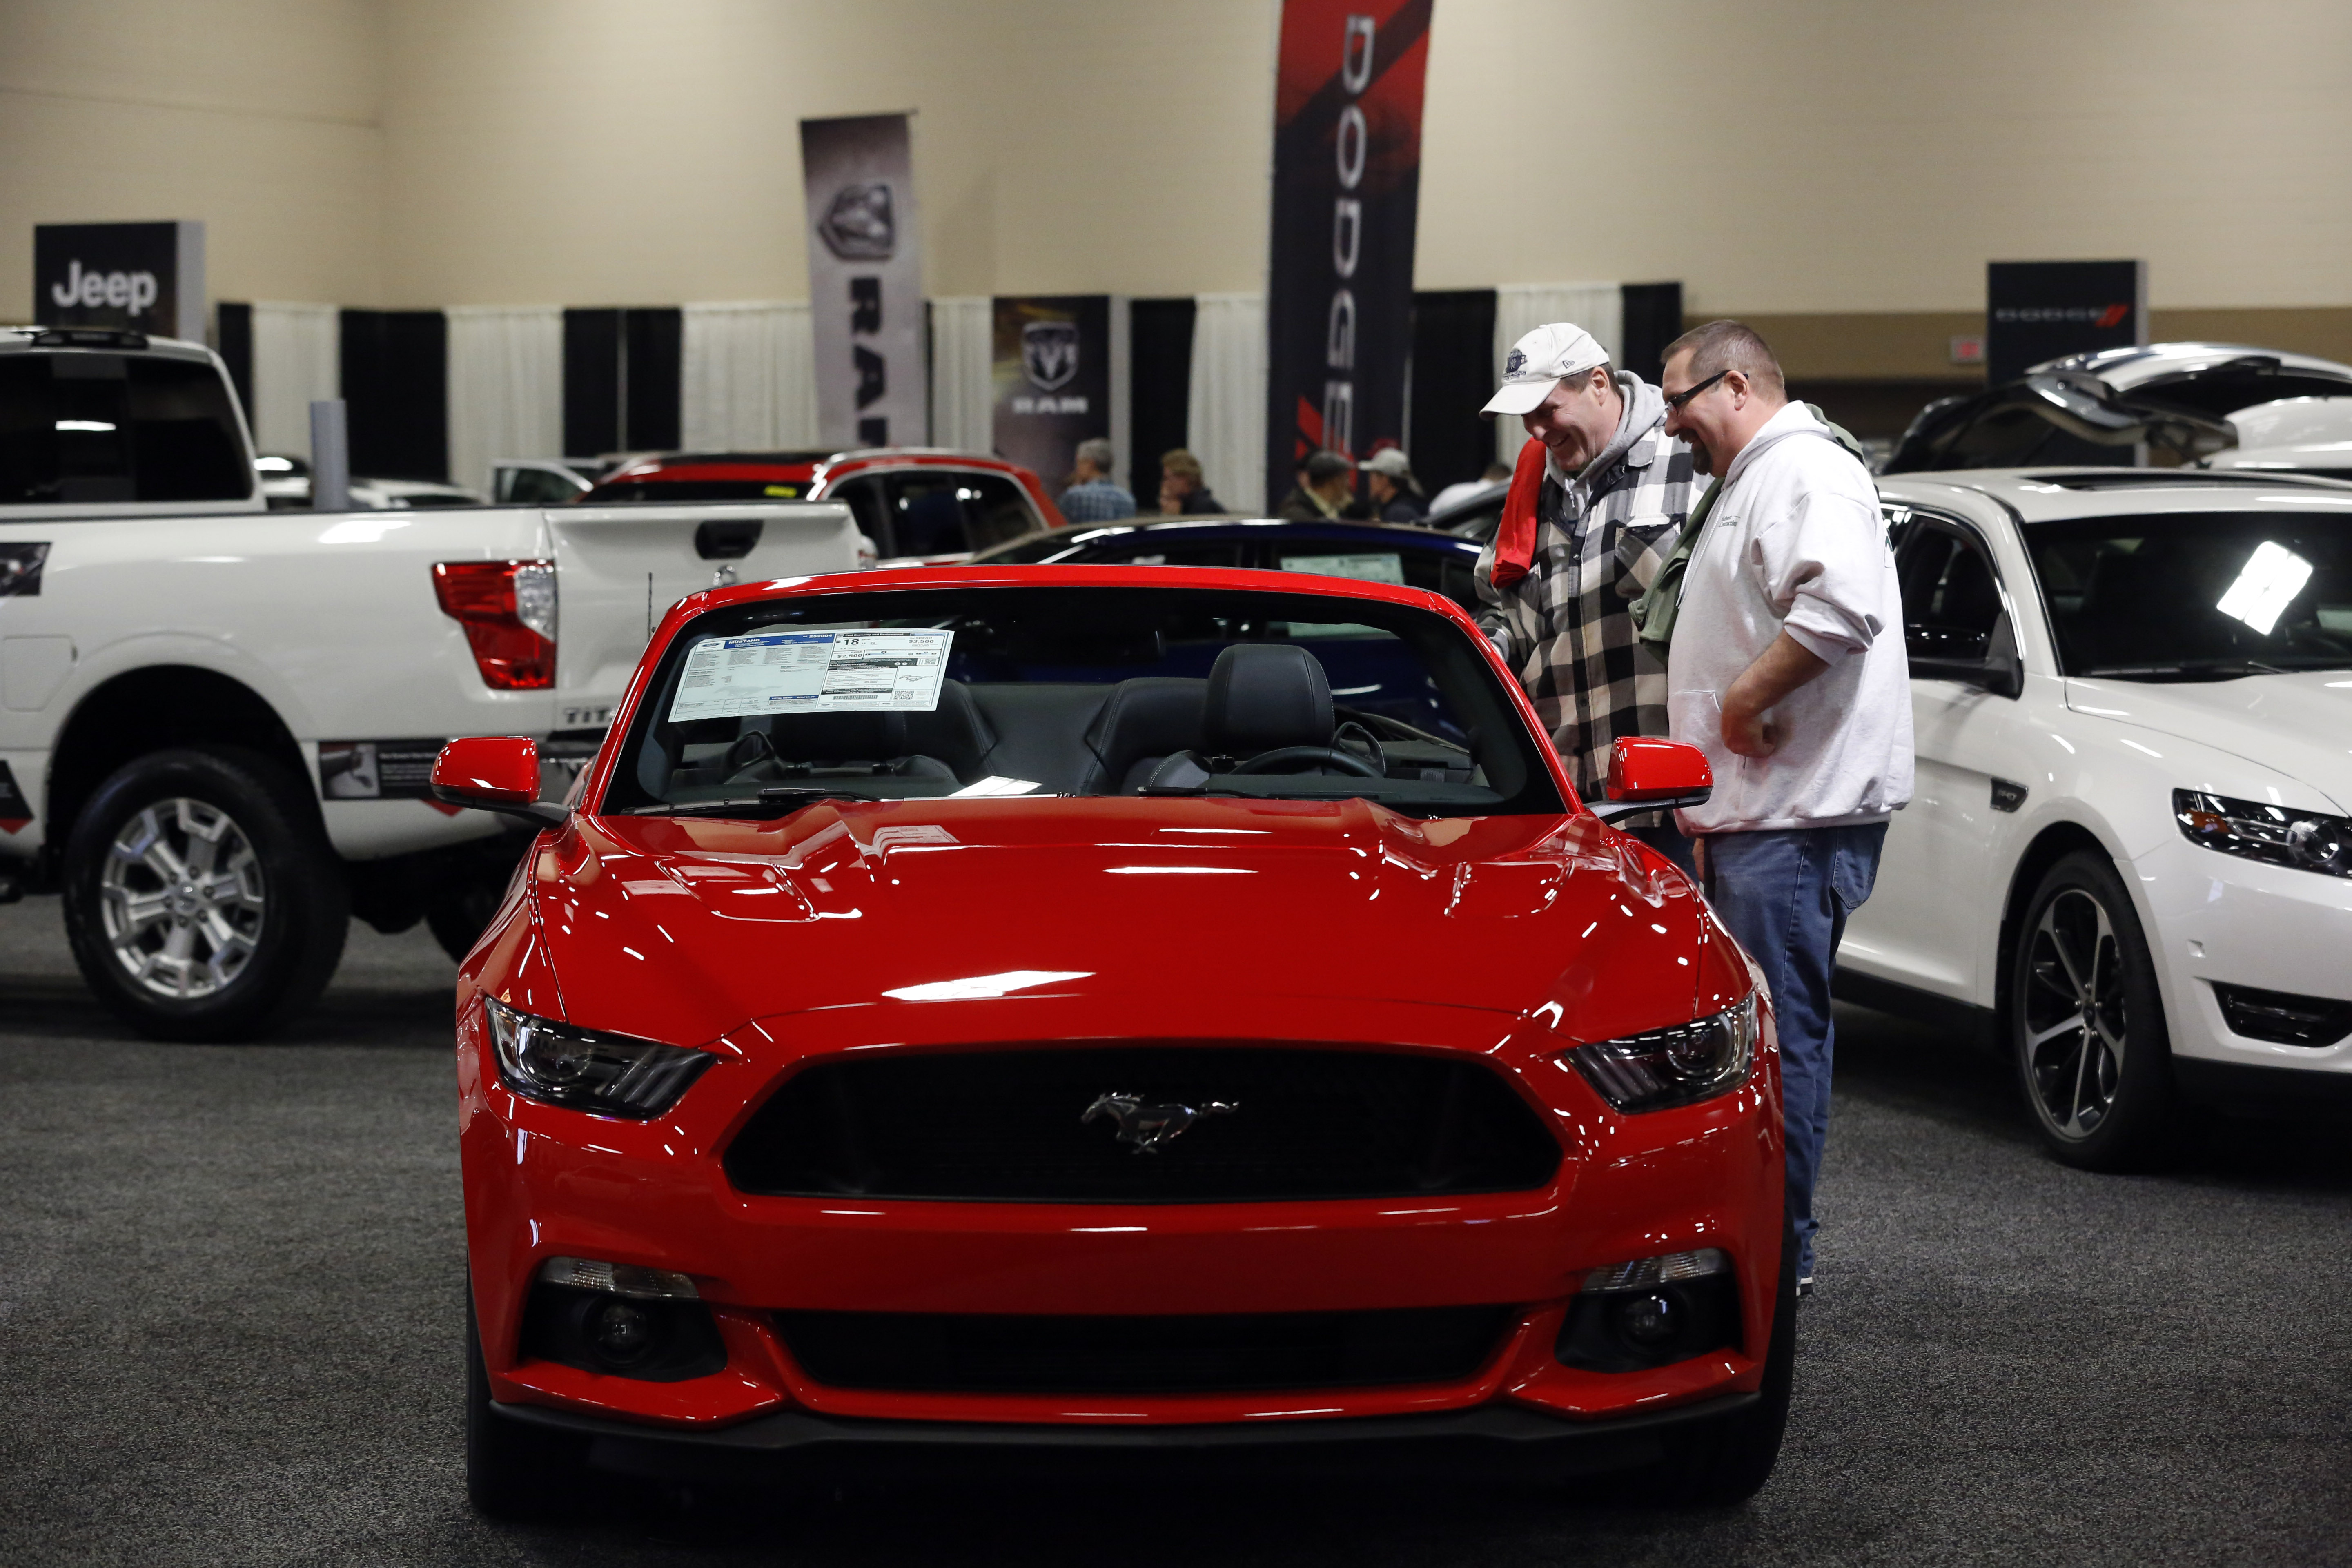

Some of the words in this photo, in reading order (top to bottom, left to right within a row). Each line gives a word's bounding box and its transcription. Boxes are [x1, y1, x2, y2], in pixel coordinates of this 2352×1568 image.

[1322, 14, 1375, 453] DODGE
[51, 260, 158, 316] Jeep
[1013, 397, 1089, 414] RAM
[563, 706, 615, 724] TIT
